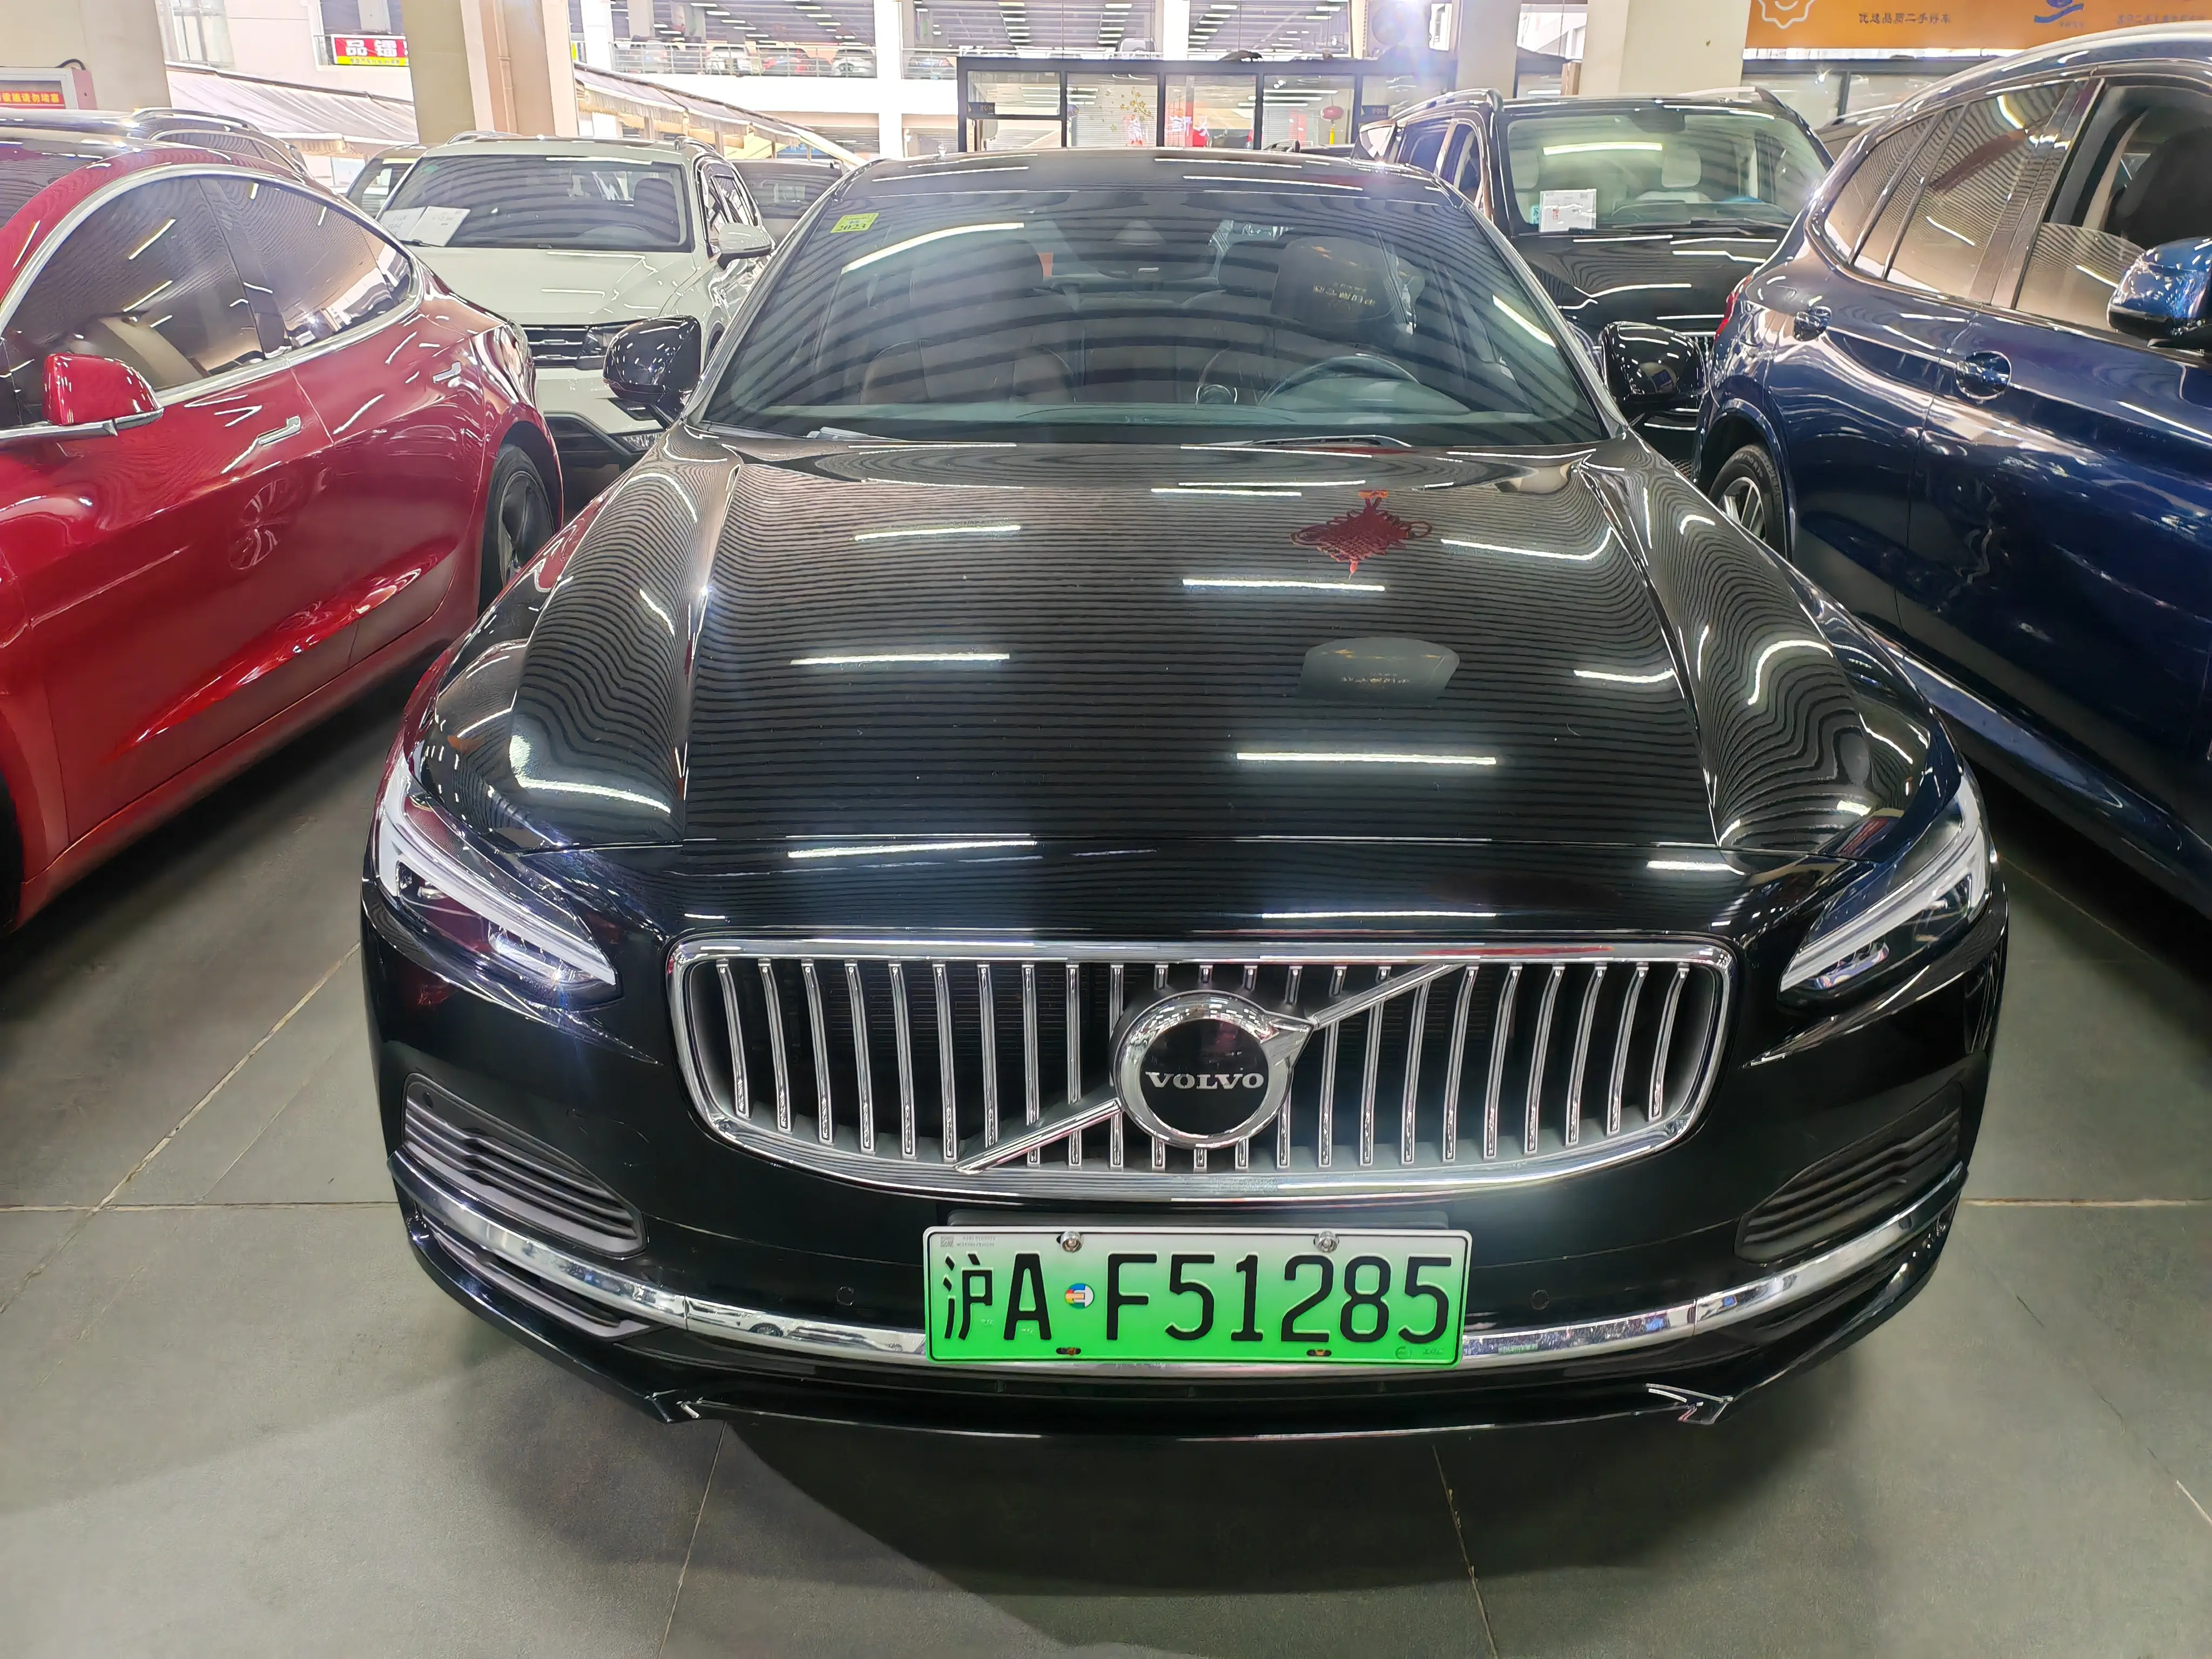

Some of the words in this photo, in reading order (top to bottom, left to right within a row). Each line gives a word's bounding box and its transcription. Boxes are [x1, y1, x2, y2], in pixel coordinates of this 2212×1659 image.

[0, 92, 59, 103] 设施请勿堵塞
[1145, 1071, 1264, 1090] VOLVO
[943, 1252, 1052, 1341] 沪A
[1106, 1253, 1452, 1344] F51285
